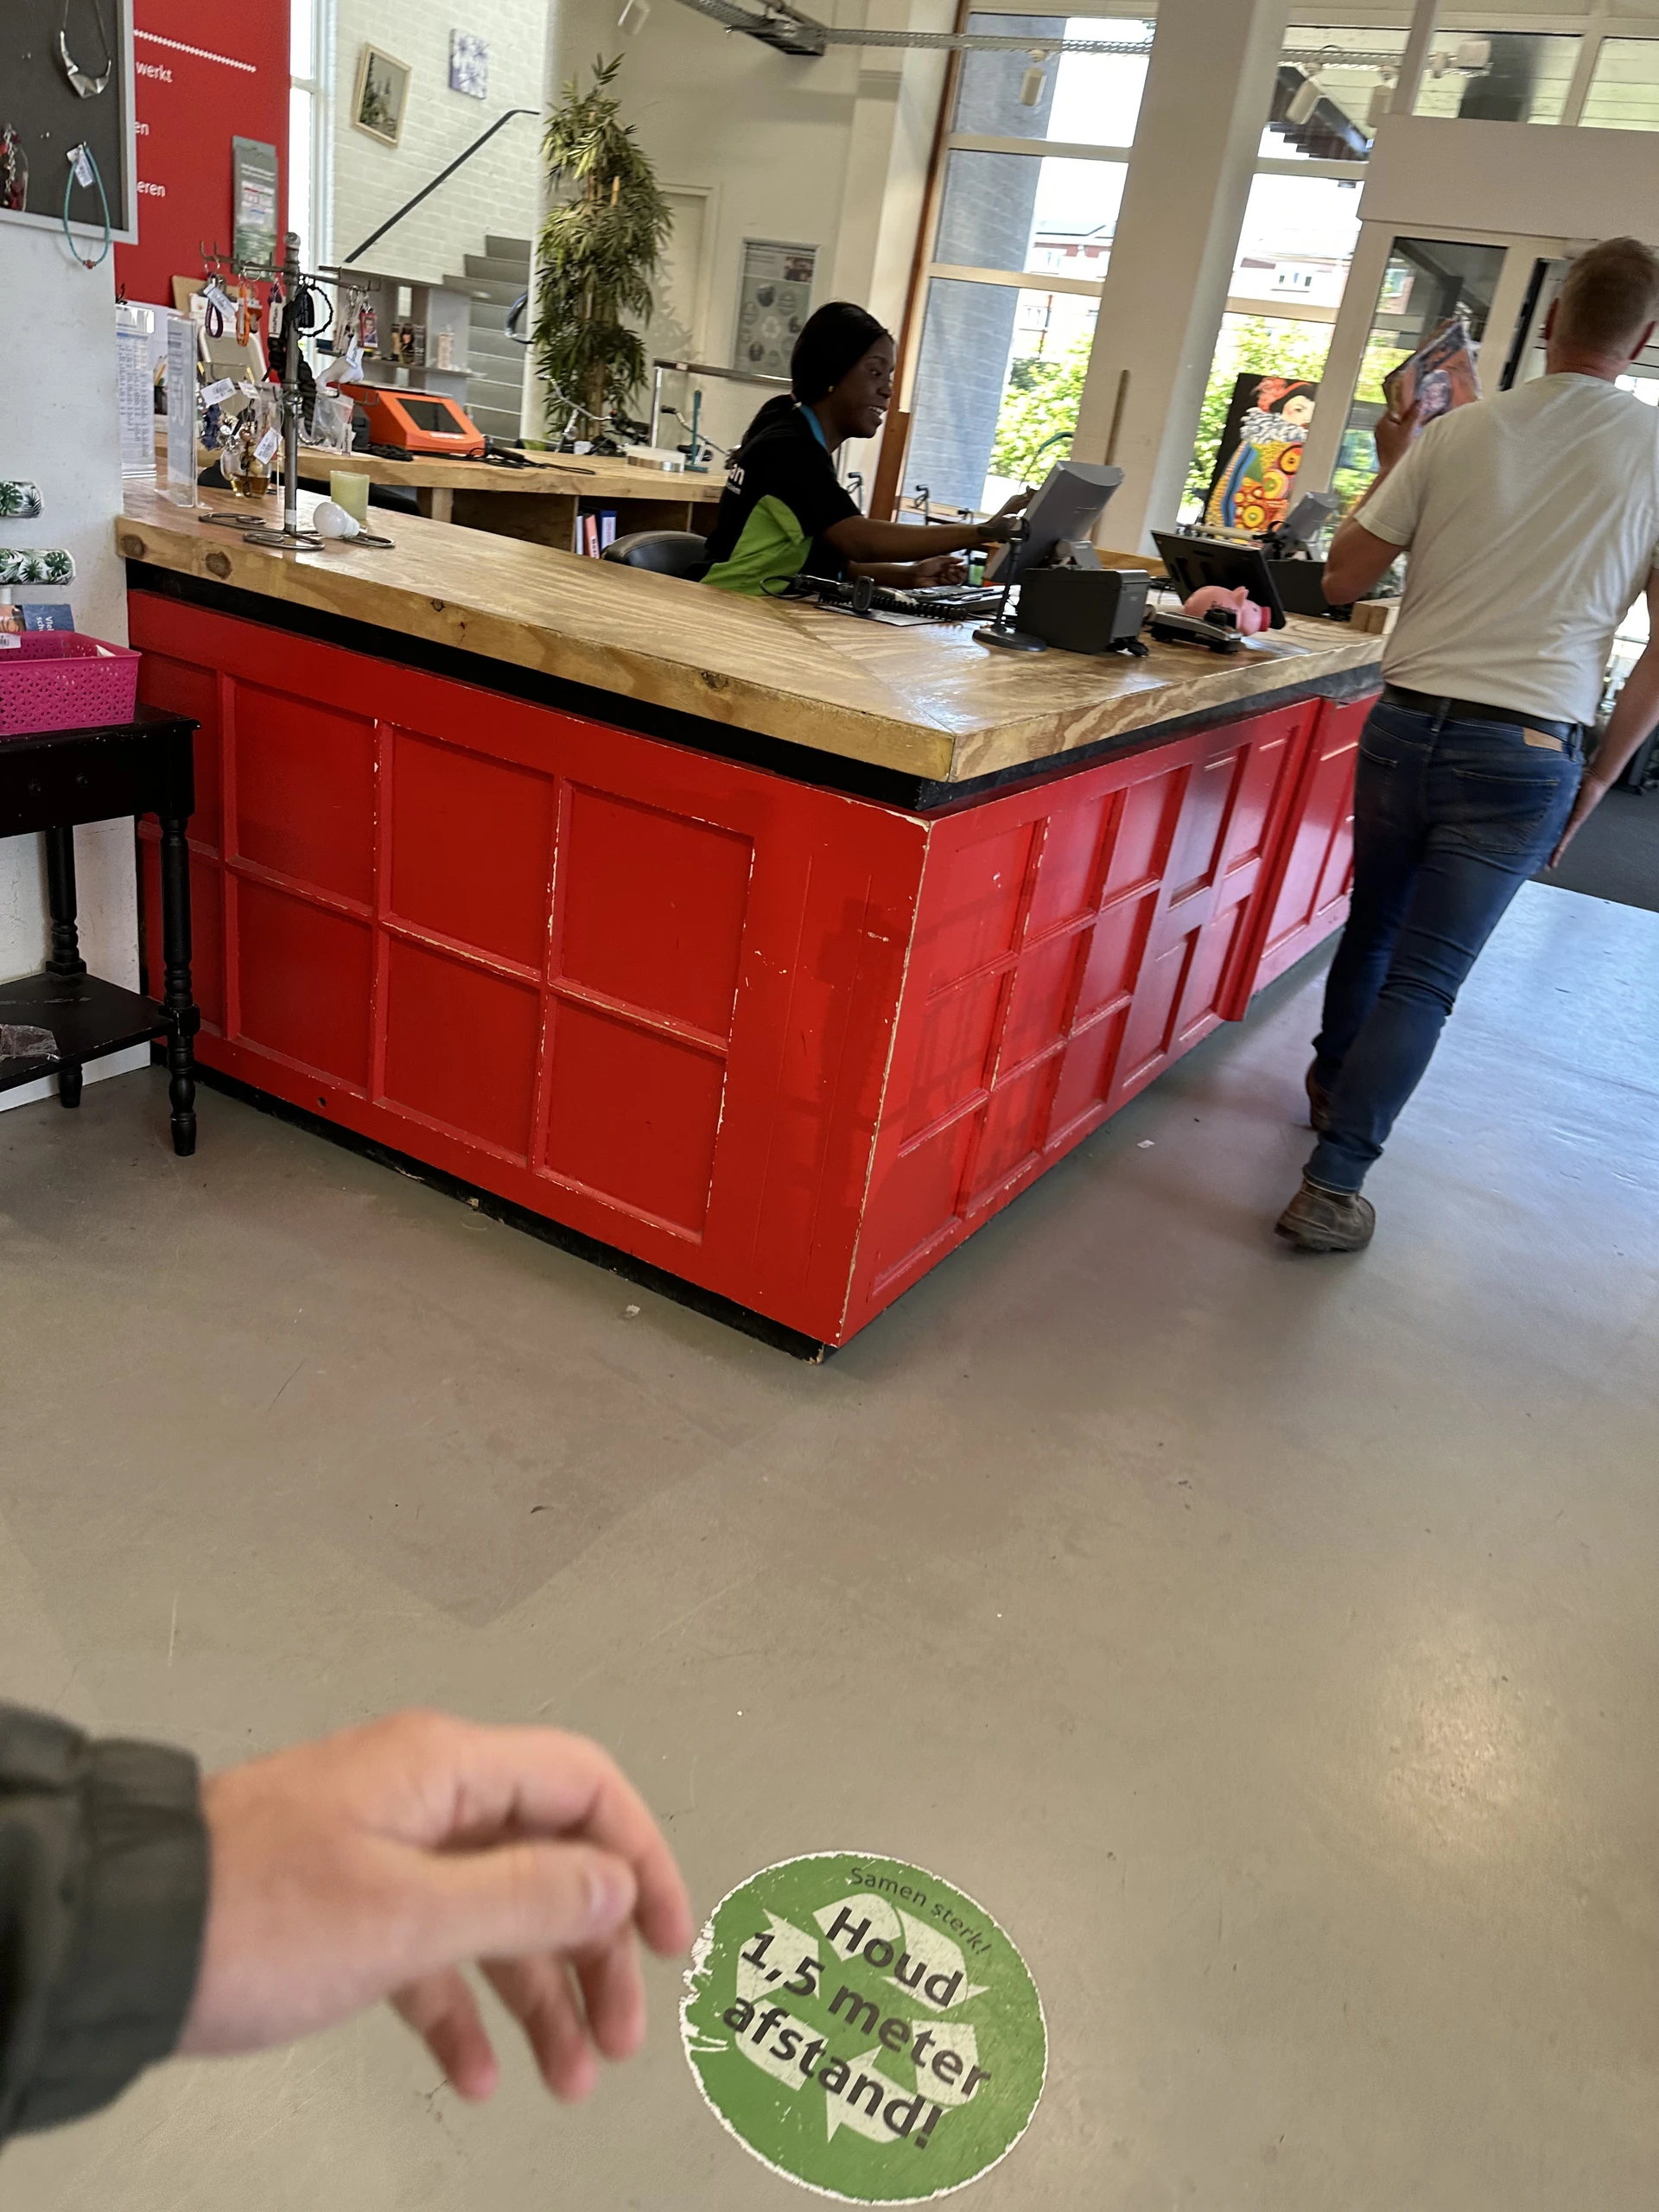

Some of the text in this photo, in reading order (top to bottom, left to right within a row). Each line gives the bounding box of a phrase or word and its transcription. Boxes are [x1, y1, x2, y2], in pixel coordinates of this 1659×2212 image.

[136, 61, 173, 83] werkt
[137, 181, 166, 198] eren
[824, 1906, 964, 2009] Houd
[850, 1866, 993, 1955] Samen sterk!
[740, 1931, 993, 2097] 1,5 meter
[722, 1996, 944, 2151] afstand!
